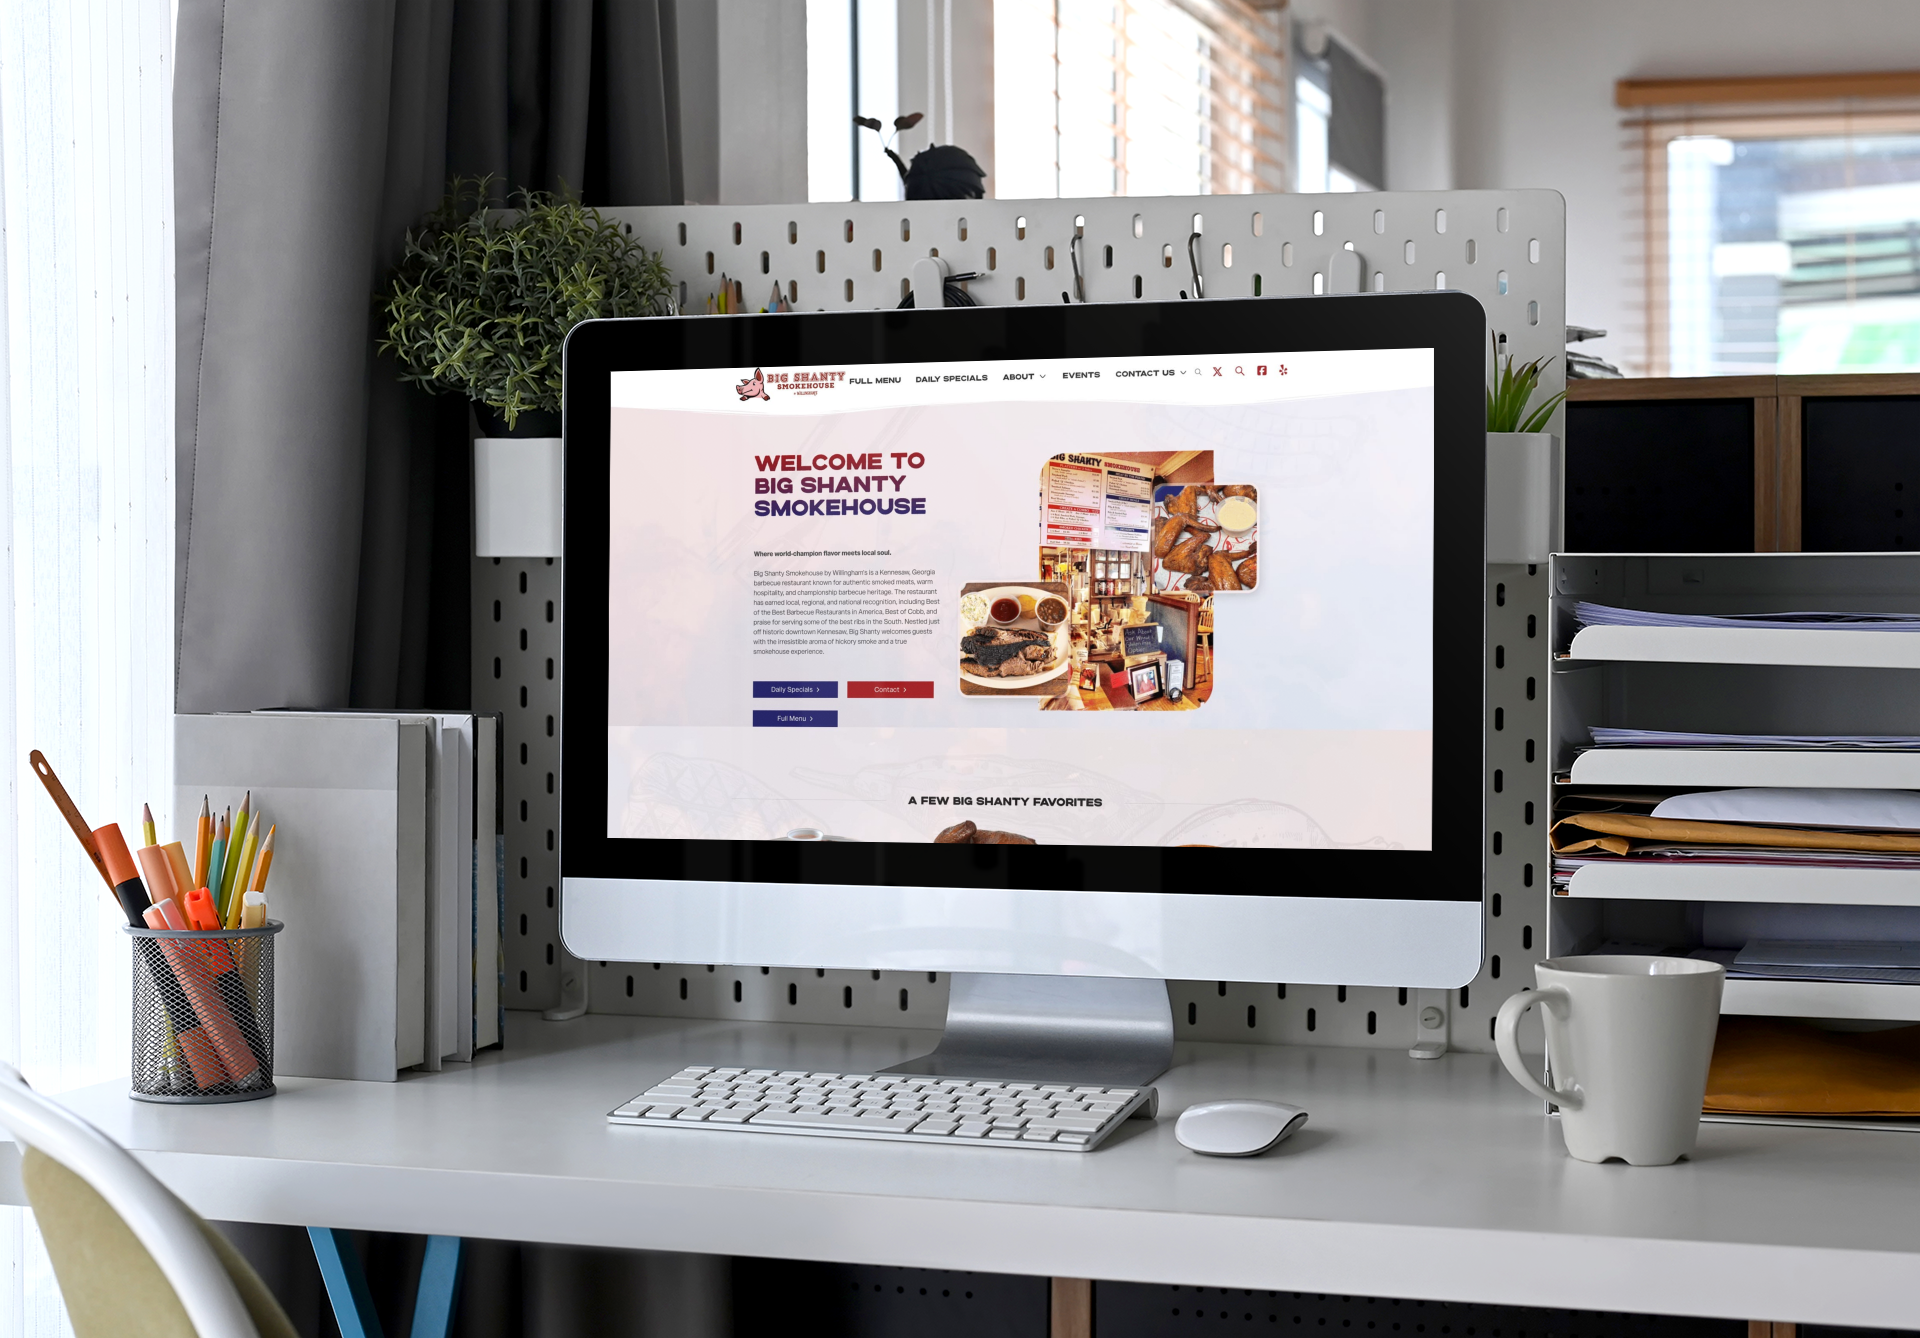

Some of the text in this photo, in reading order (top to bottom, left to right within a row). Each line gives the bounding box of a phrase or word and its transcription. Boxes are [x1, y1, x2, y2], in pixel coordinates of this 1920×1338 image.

[767, 371, 846, 383] BIG SHANTY
[915, 374, 988, 383] DAILY SPECIALS
[1002, 373, 1035, 381] ABOUT
[1062, 371, 1101, 379] EVENTS
[777, 382, 835, 390] SMOKEHOUSE
[754, 452, 925, 472] WELCOME TO
[755, 475, 907, 494] BIG SHANTY
[754, 498, 926, 517] SMOKEHOUSE
[832, 570, 868, 578] Willingham's
[911, 569, 936, 577] Georgia
[866, 589, 893, 597] heritage.
[862, 599, 898, 607] recognition,
[898, 599, 925, 607] including
[753, 619, 771, 627] praise
[781, 619, 803, 627] serving
[848, 629, 859, 637] Big
[771, 686, 813, 694] Daily Specials
[908, 796, 1103, 807] A FEW BIG SHANTY FAVORITES
